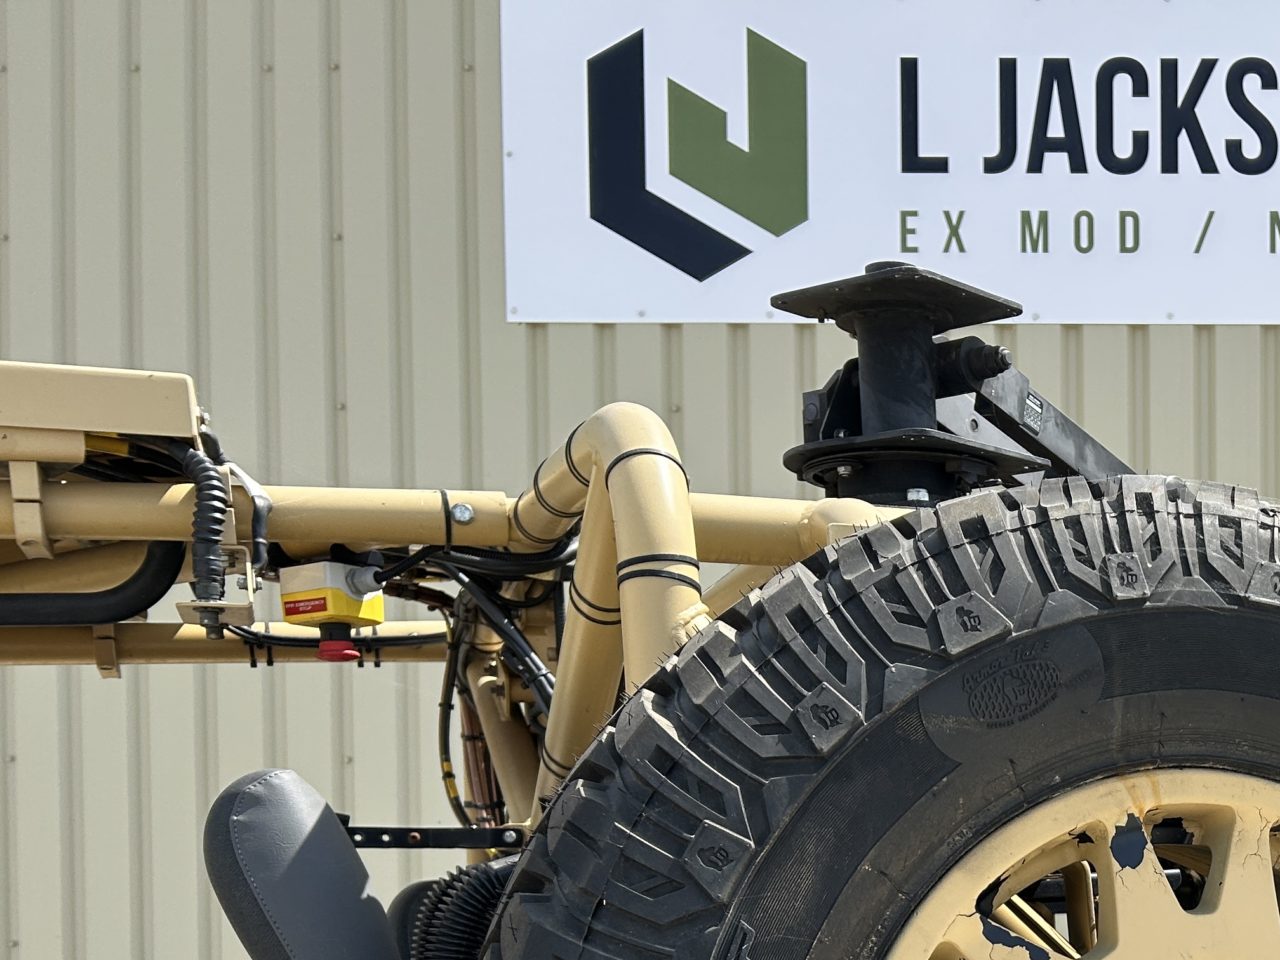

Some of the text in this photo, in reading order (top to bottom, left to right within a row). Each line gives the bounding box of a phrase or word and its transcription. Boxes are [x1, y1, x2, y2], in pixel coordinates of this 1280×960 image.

[900, 57, 949, 173] L
[901, 211, 966, 253] EX
[1021, 211, 1139, 253] MOD
